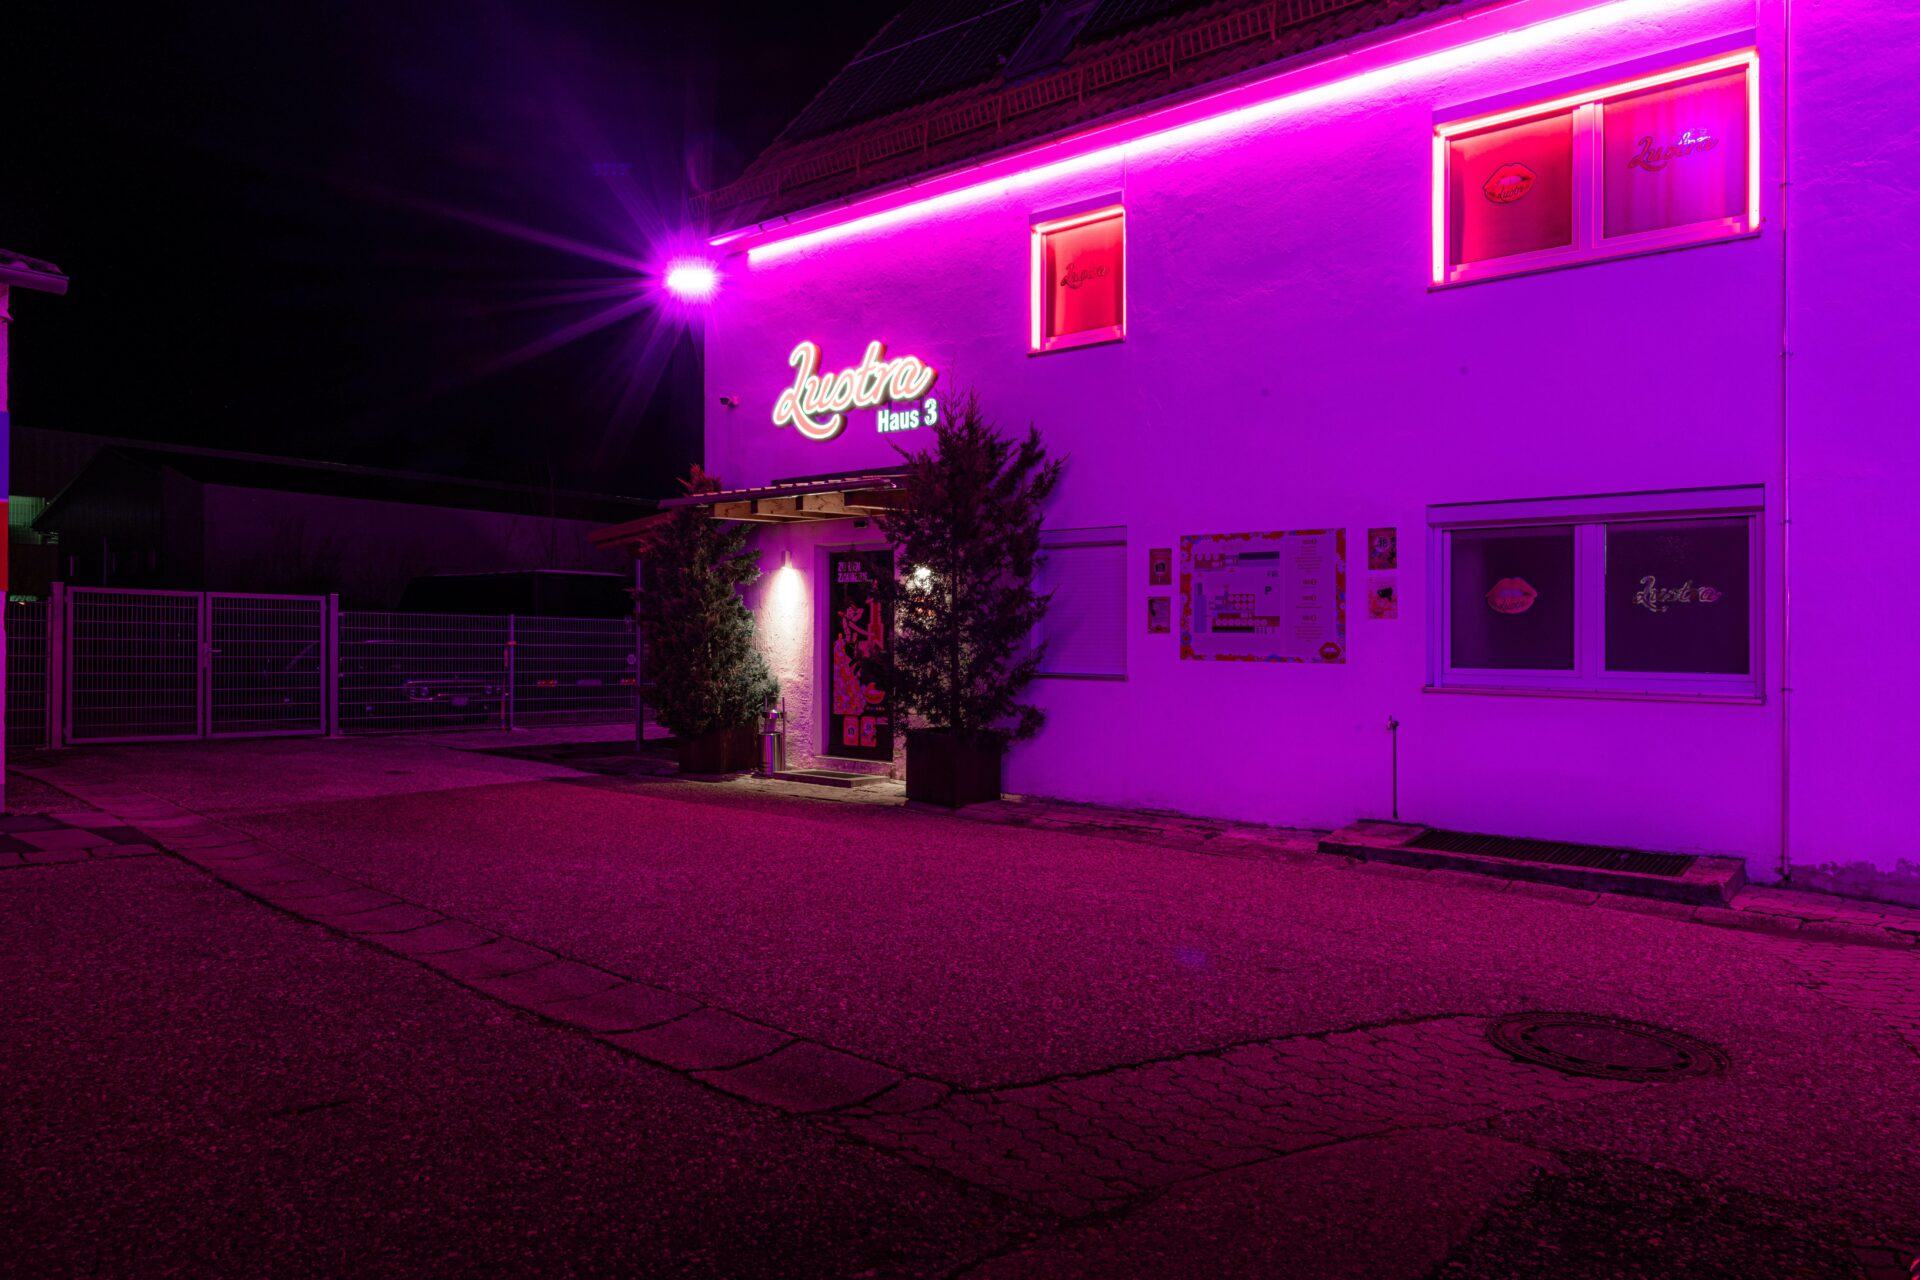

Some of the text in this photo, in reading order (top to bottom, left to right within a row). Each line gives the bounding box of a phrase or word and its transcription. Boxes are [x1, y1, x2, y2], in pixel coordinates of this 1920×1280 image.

[773, 340, 937, 440] Lustra
[877, 398, 938, 433] Haus 3
